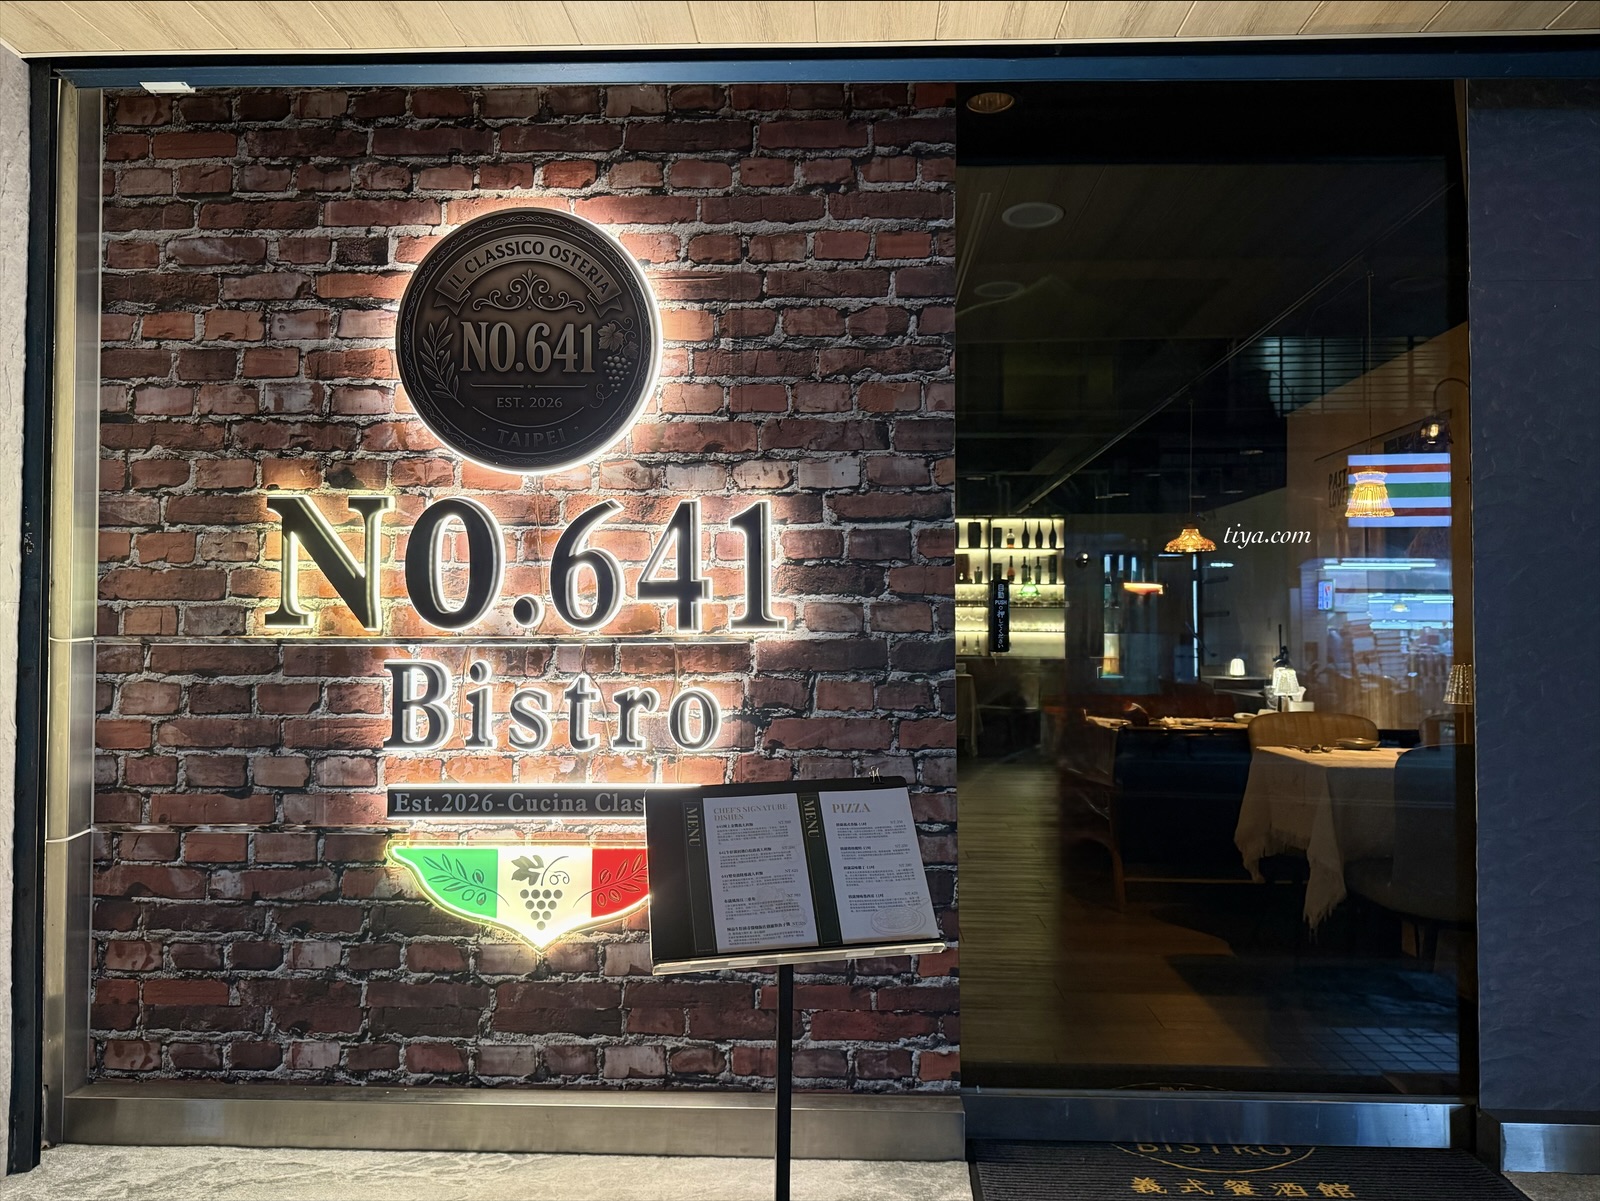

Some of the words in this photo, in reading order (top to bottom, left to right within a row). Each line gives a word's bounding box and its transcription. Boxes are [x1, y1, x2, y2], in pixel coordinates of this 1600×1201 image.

[447, 275, 466, 290] IL
[464, 240, 545, 275] CLASSICO
[549, 244, 611, 295] OSTERIA
[459, 320, 596, 374] NO.641
[496, 397, 524, 409] EST.
[529, 397, 563, 409] 2026
[498, 427, 567, 448] TAIPEI
[263, 495, 788, 632] NO.641
[383, 659, 722, 752] Bistro
[713, 806, 741, 815] CHEF'S
[742, 803, 789, 813] SIGNATURE
[714, 813, 744, 821] DISHES
[802, 800, 820, 838] MENU
[831, 802, 871, 814] PIZZA
[686, 807, 700, 847] MENU
[1130, 1176, 1357, 1199] 義式餐酒館
